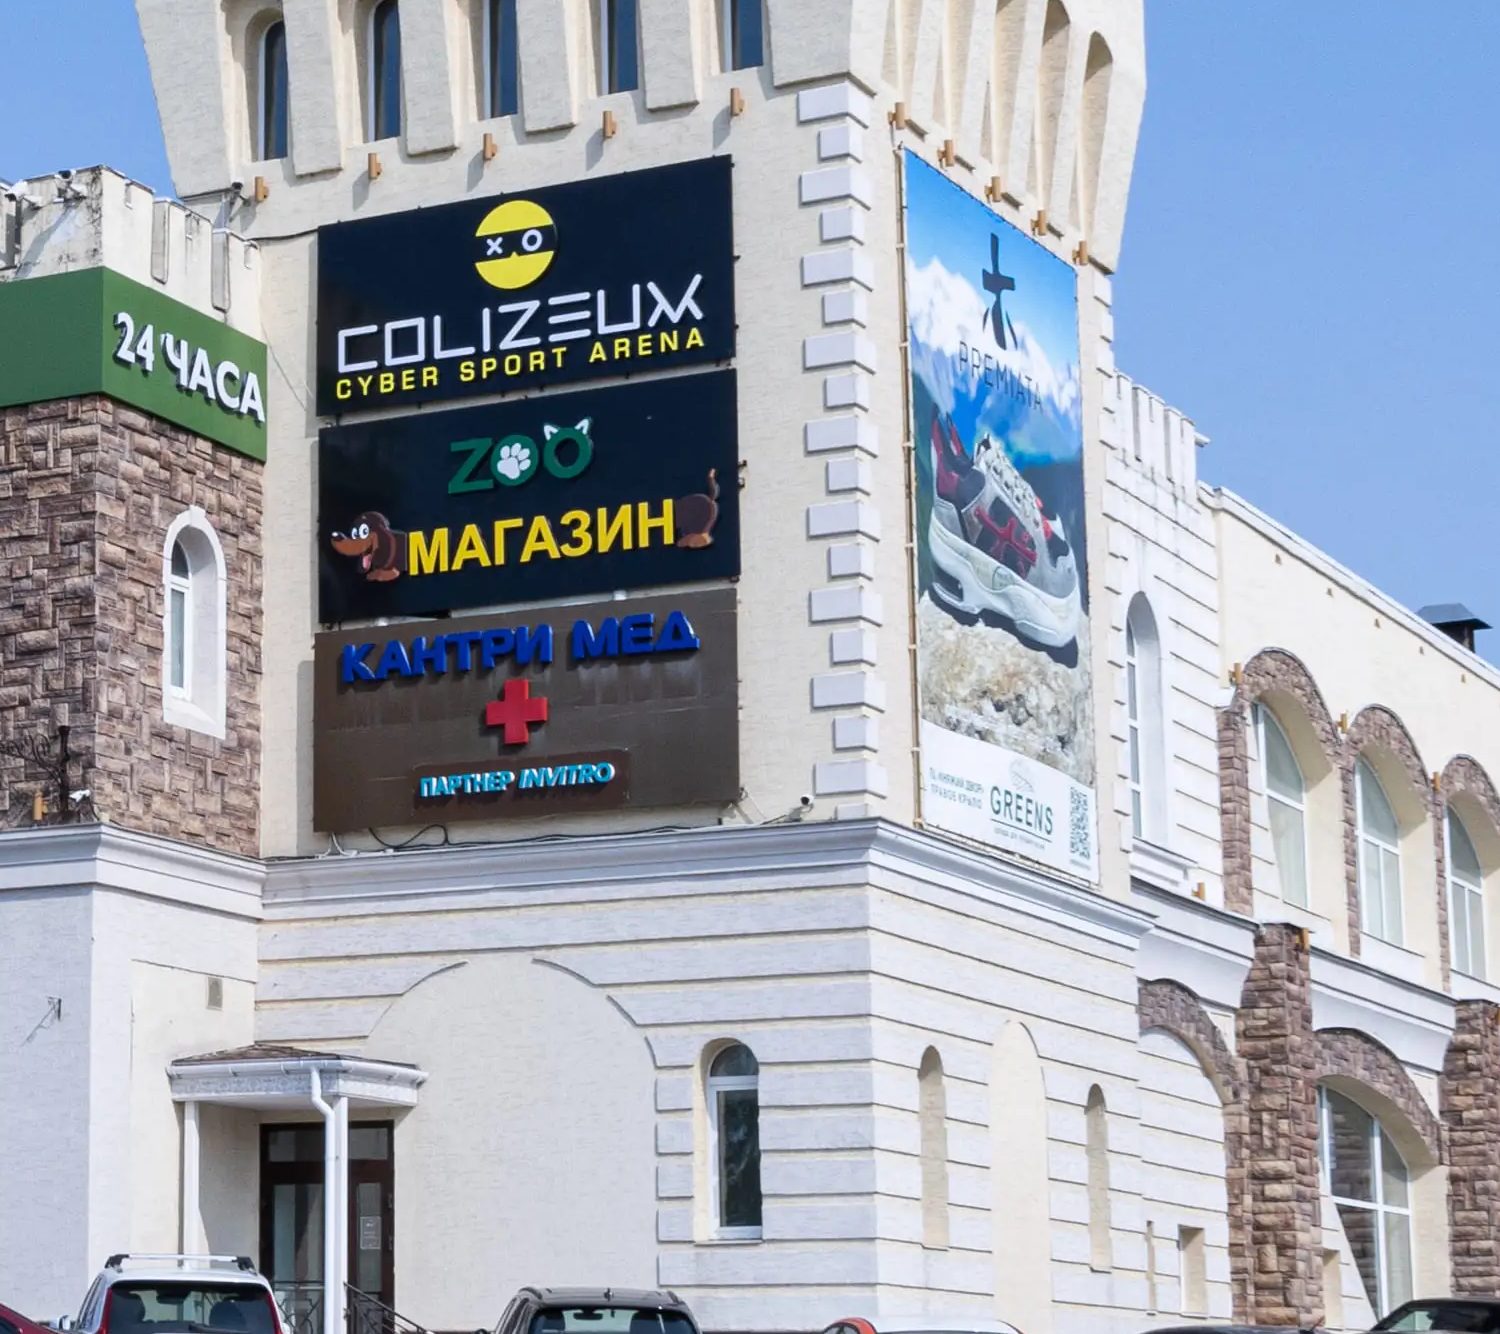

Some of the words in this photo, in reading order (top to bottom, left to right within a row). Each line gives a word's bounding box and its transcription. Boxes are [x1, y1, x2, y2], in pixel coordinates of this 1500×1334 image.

[114, 311, 155, 372] 24
[162, 333, 265, 422] ЧАСА
[336, 366, 439, 400] CYBER
[460, 347, 567, 382] SPORT
[589, 328, 705, 364] ARENA
[959, 340, 1043, 413] PREMIATA
[448, 422, 594, 495] ZOO
[408, 498, 676, 576] МАГАЗИН
[342, 624, 553, 683] КАНТРИ
[572, 611, 700, 659] МЕД
[420, 771, 514, 798] ПАРТНЕР
[518, 763, 615, 788] INVITRO
[990, 786, 1053, 835] GREENS
